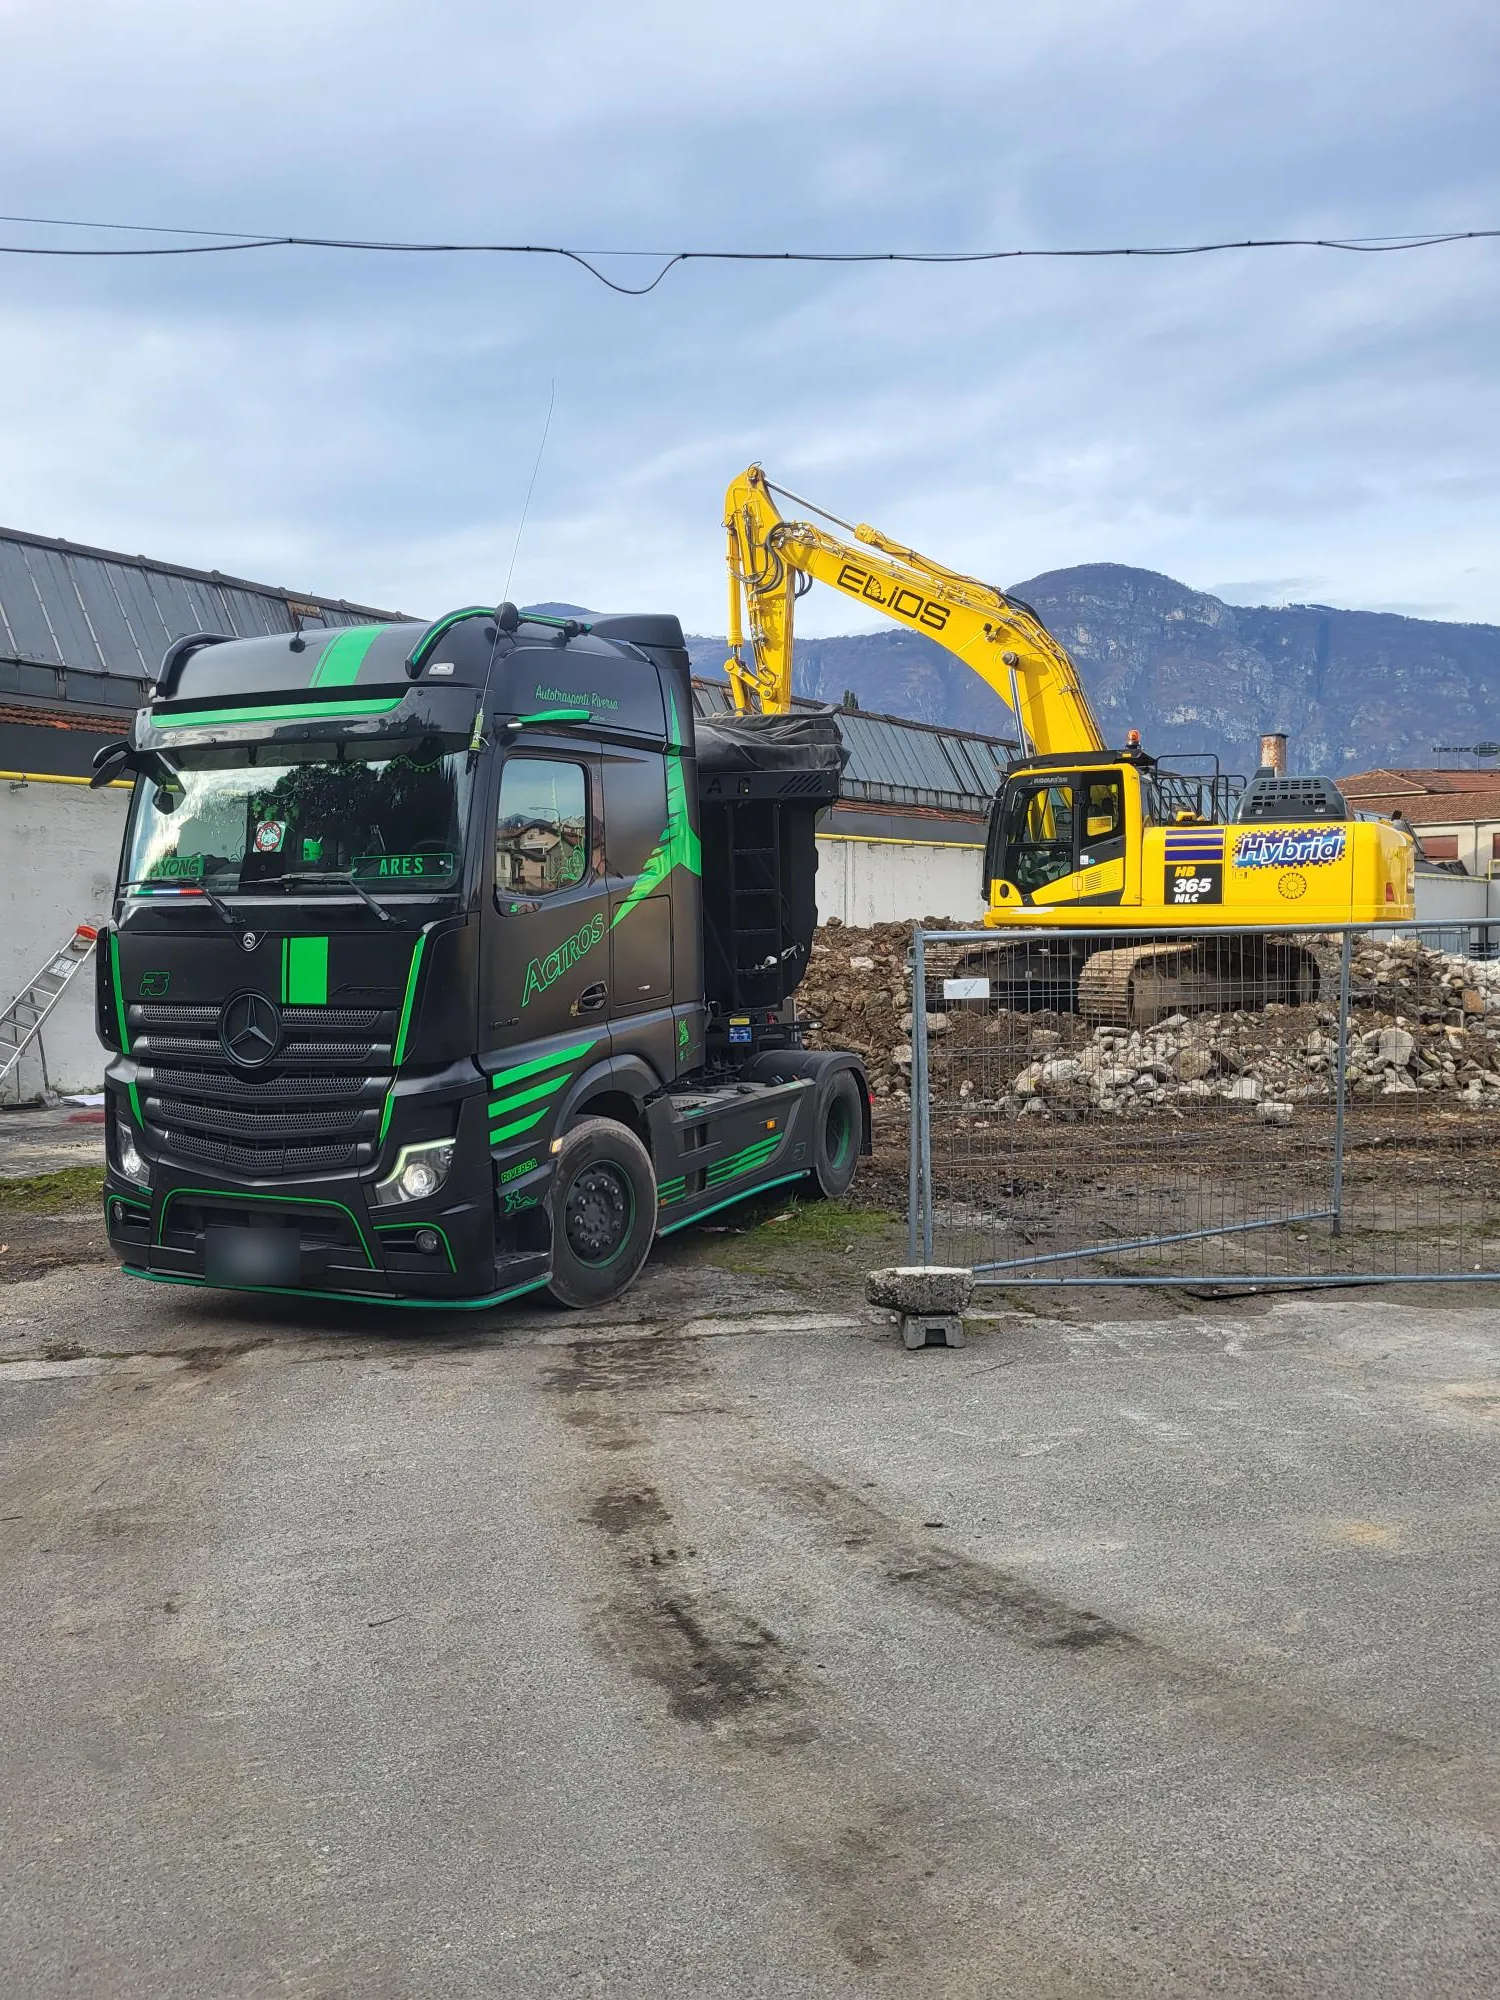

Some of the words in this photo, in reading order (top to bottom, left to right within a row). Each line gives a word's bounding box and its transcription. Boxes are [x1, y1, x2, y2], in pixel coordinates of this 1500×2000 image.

[535, 684, 590, 707] Autotrasporti
[591, 692, 619, 710] Riversa
[1238, 836, 1342, 865] Hybrid
[380, 858, 423, 875] ARES
[1174, 866, 1196, 877] HB
[1173, 878, 1212, 893] 365
[1174, 893, 1199, 903] NLC
[501, 1158, 538, 1183] RIVERSA
